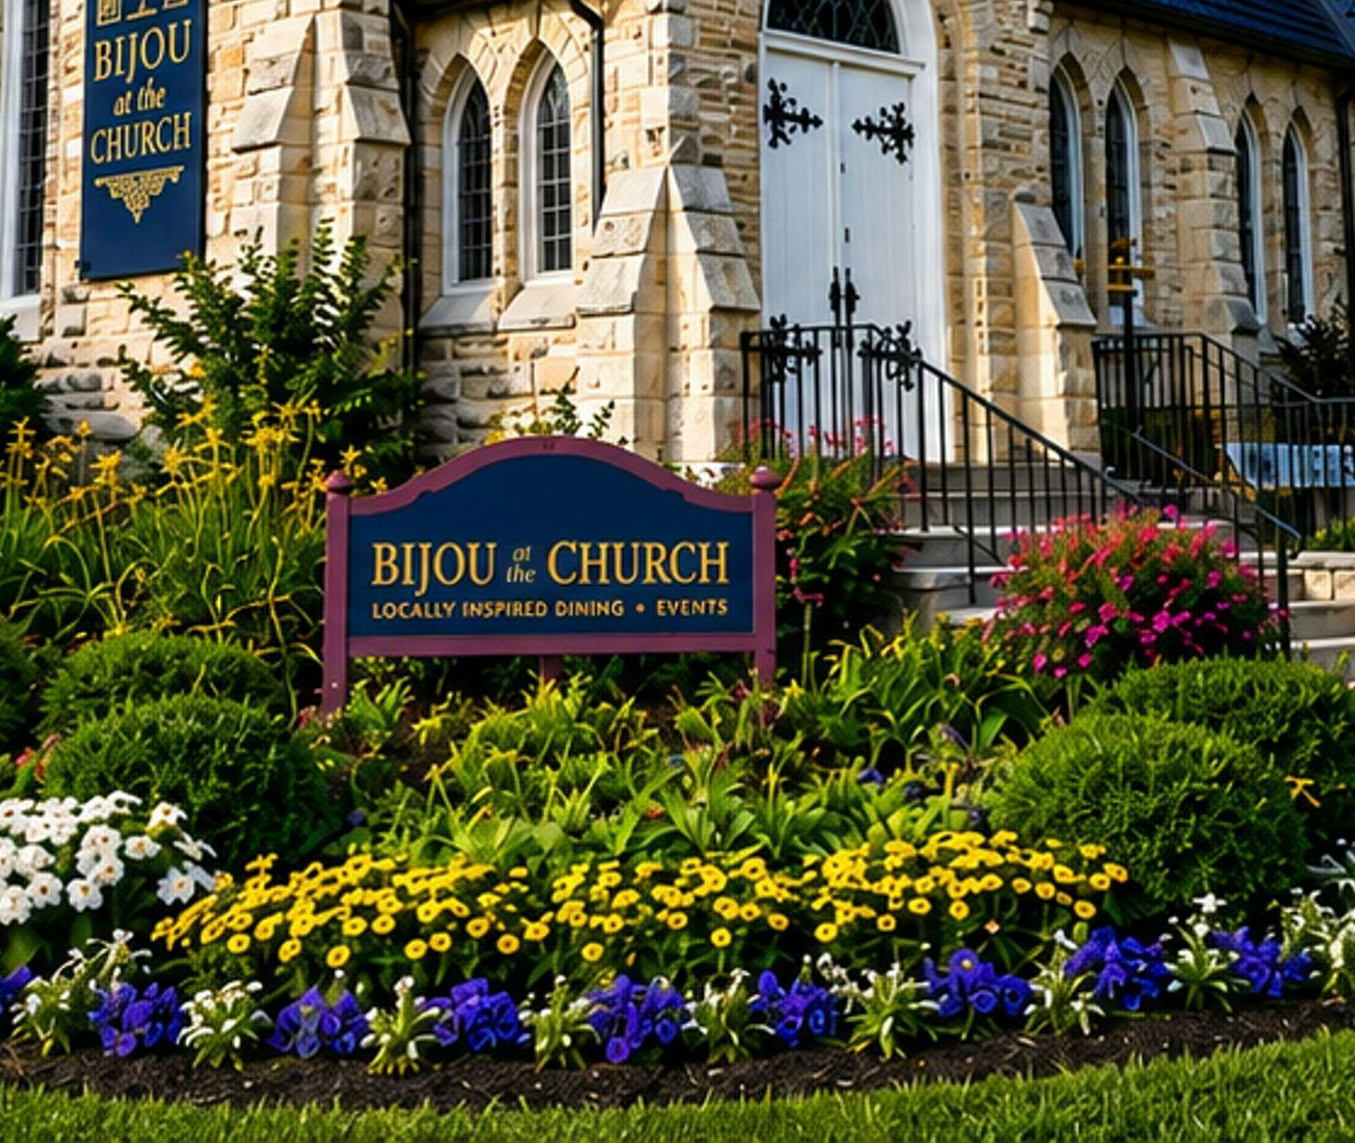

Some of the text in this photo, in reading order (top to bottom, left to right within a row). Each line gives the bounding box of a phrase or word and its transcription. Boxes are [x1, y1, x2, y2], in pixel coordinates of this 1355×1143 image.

[94, 20, 192, 84] BIJOU
[113, 77, 166, 116] at the
[91, 111, 192, 164] CHURCH
[371, 541, 497, 597] BIJOU
[506, 565, 536, 584] the
[512, 546, 531, 563] at
[546, 539, 730, 586] CHURCH
[372, 597, 730, 620] LOCALLY INSPIRED DINING EVENTS
